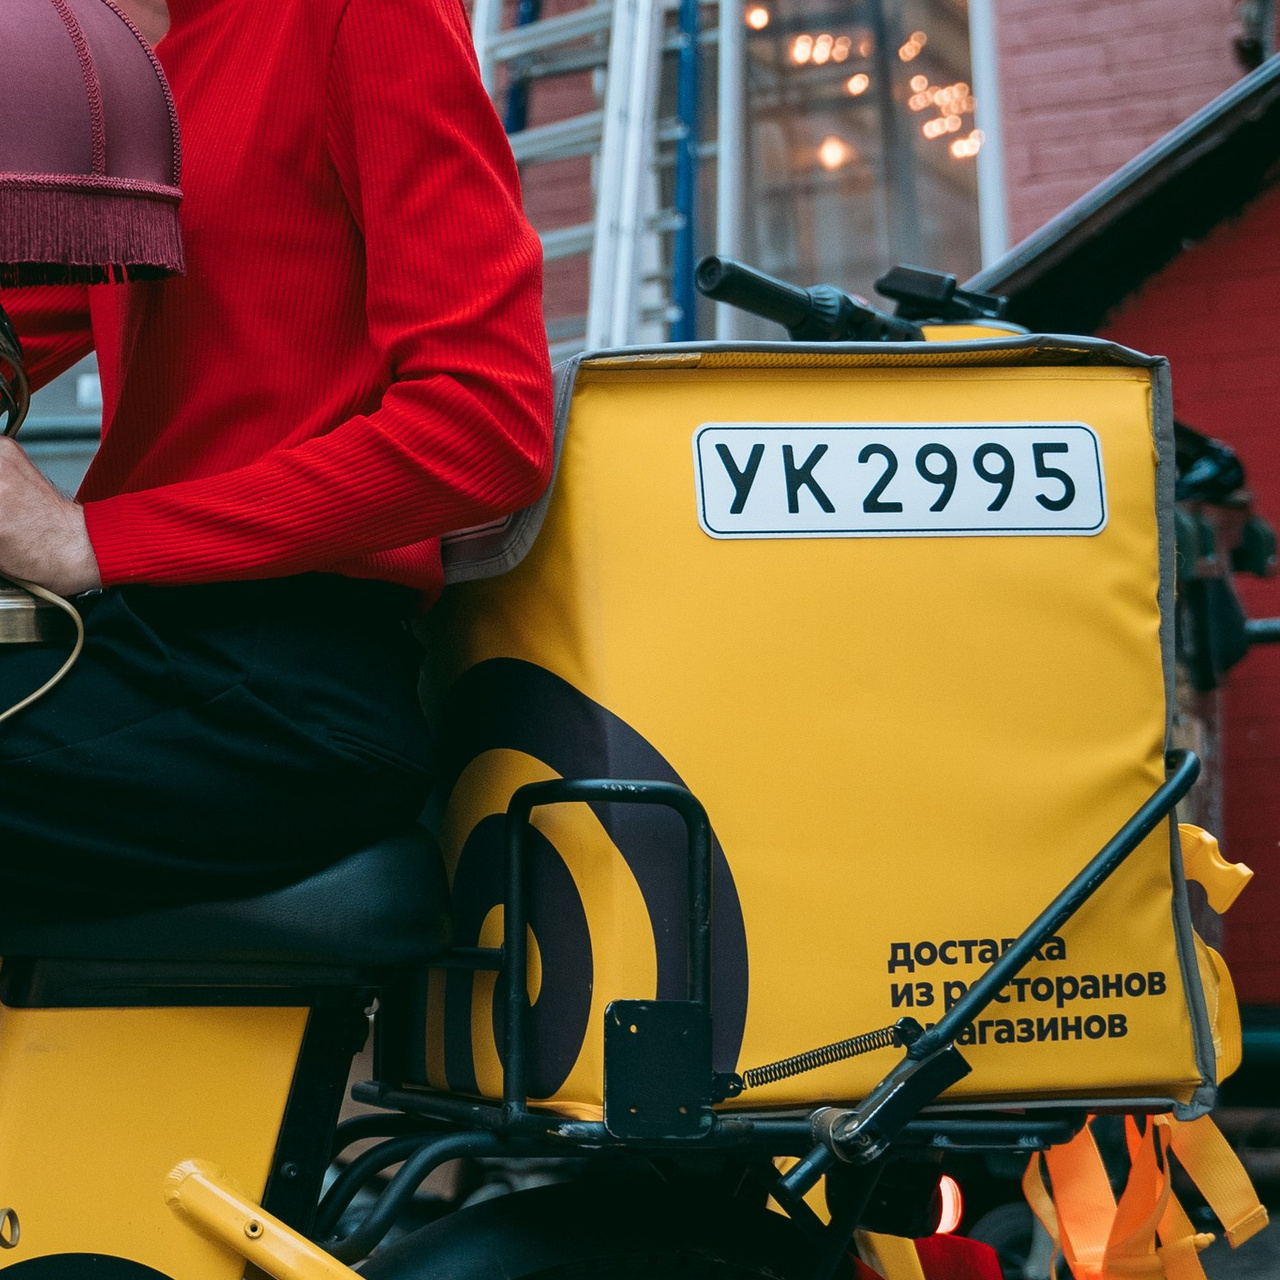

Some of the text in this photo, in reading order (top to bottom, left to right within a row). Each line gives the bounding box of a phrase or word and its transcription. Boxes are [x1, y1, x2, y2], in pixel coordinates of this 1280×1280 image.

[887, 934, 1067, 974] достаа
[890, 970, 1167, 1014] из рсторанов
[925, 1013, 1129, 1047] агазинов
